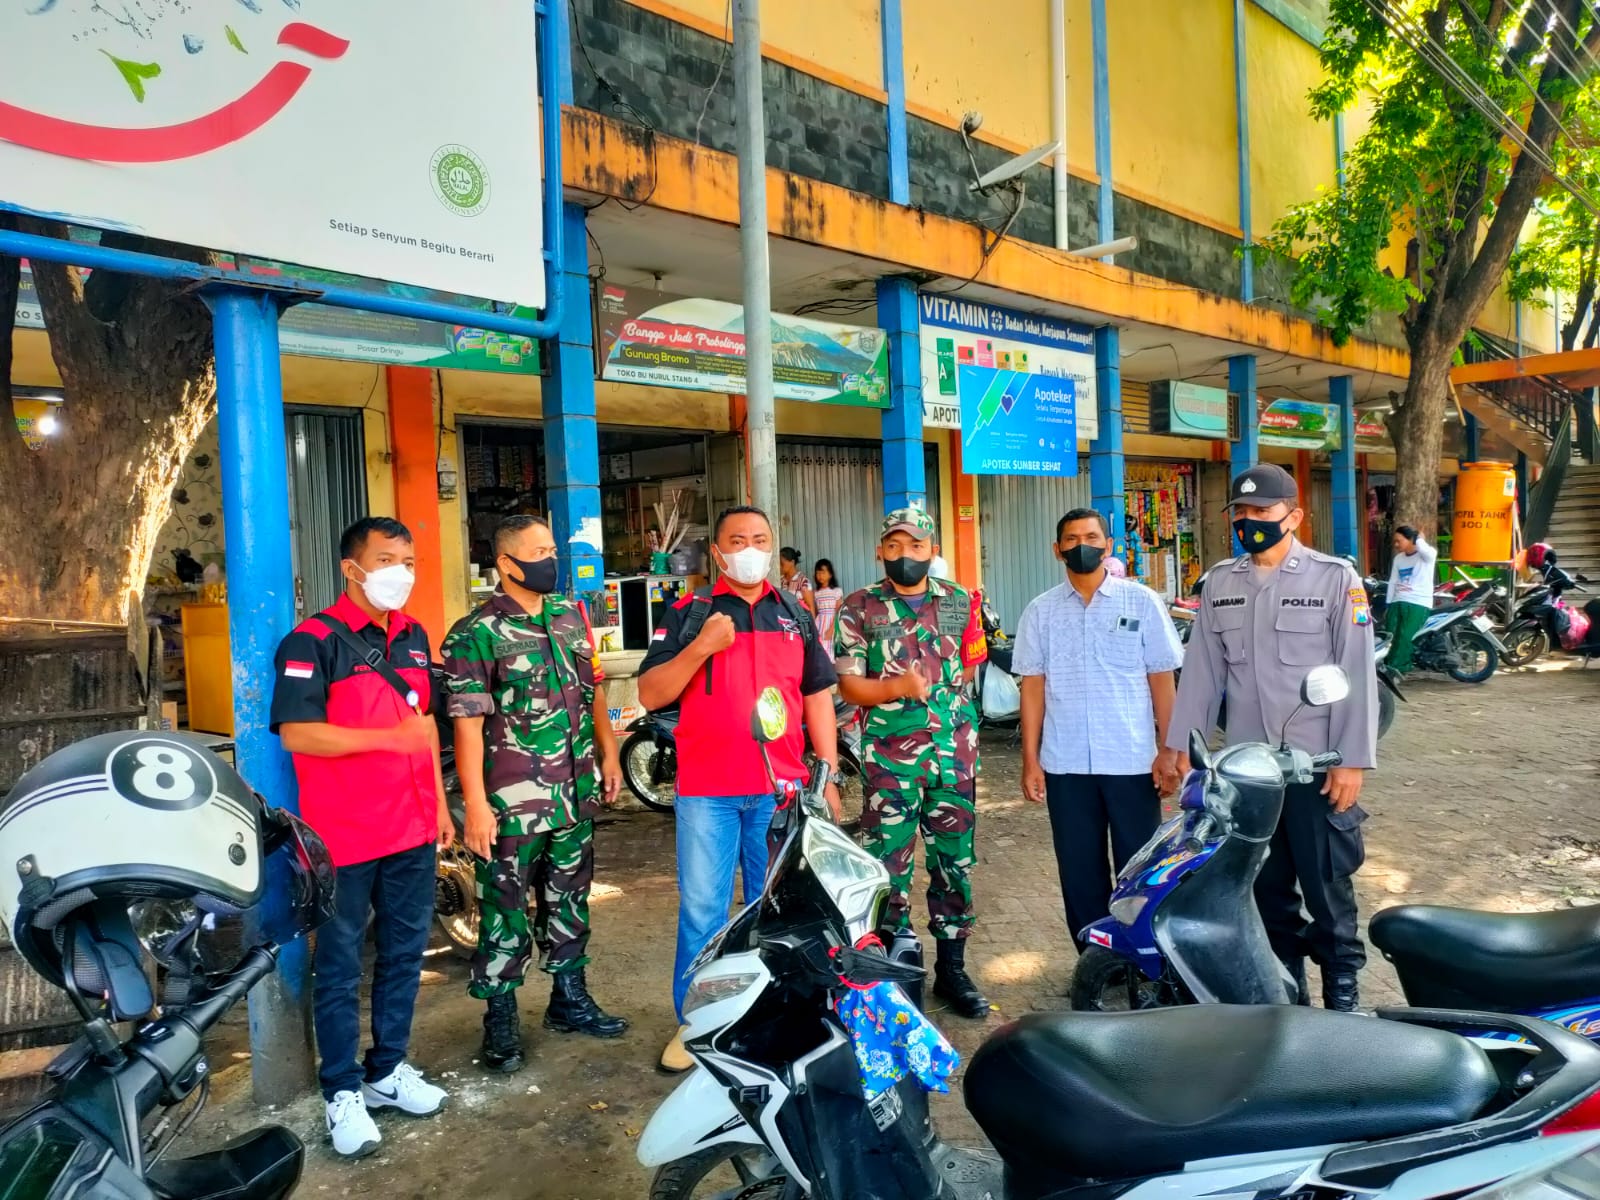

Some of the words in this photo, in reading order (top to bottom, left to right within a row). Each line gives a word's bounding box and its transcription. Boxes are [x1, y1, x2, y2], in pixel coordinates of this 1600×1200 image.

[329, 219, 368, 236] Setiap
[371, 228, 417, 246] Senyum
[420, 238, 456, 255] Begitu
[459, 247, 495, 263] Berarti
[922, 295, 989, 330] VITAMIN
[1004, 314, 1024, 332] Badan
[623, 321, 667, 344] Bangga
[668, 328, 693, 344] Jadi
[695, 332, 746, 355] Probolingg
[625, 347, 660, 364] Gunung
[660, 351, 690, 365] Bromo
[616, 368, 636, 378] TOKO
[637, 370, 647, 379] BU
[648, 372, 671, 381] NURUL
[672, 375, 692, 384] STAND
[693, 376, 699, 384] 4
[939, 362, 948, 380] A
[1034, 387, 1072, 404] Apoteker
[981, 458, 1012, 470] APOTEK
[1012, 459, 1041, 471] SUMBER
[1041, 461, 1062, 472] SEHAT
[1479, 511, 1507, 520] TANK
[1281, 598, 1325, 608] POLISI
[495, 639, 540, 656] SUPRIADI
[132, 745, 196, 801] 8
[739, 1084, 770, 1104] FI
